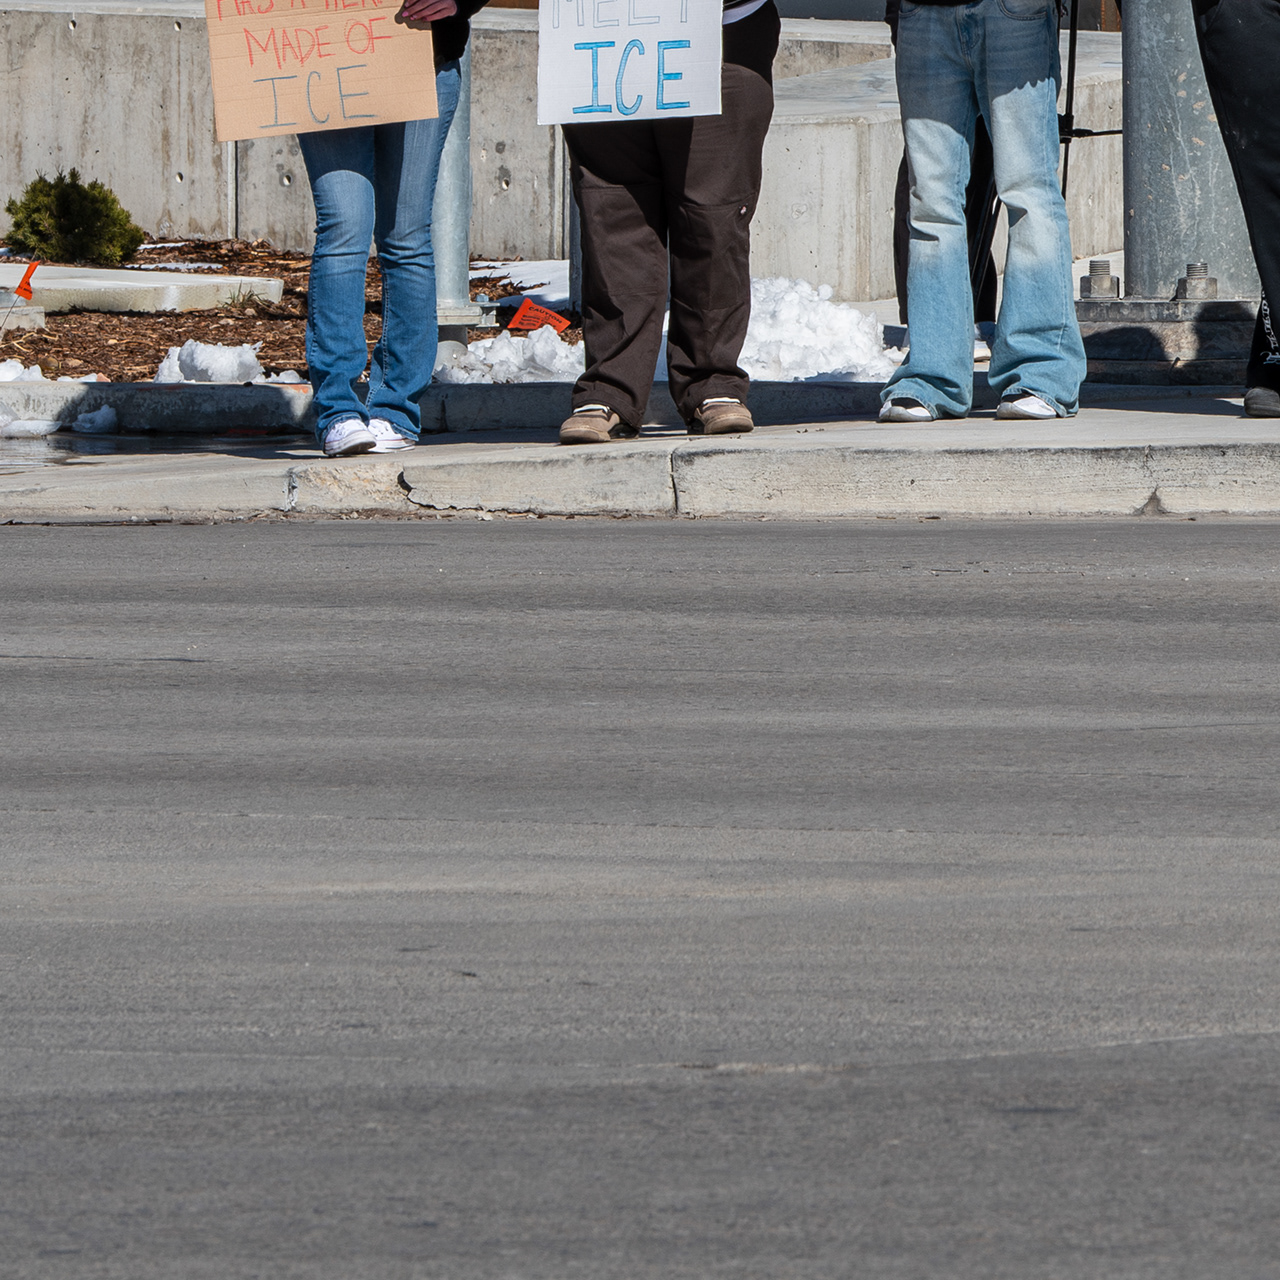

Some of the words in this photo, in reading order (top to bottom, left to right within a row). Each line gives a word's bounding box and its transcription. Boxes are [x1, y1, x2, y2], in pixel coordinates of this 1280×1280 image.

[243, 26, 337, 70] MADE
[344, 16, 393, 56] OF
[252, 64, 379, 130] ICE
[572, 38, 692, 116] ICE
